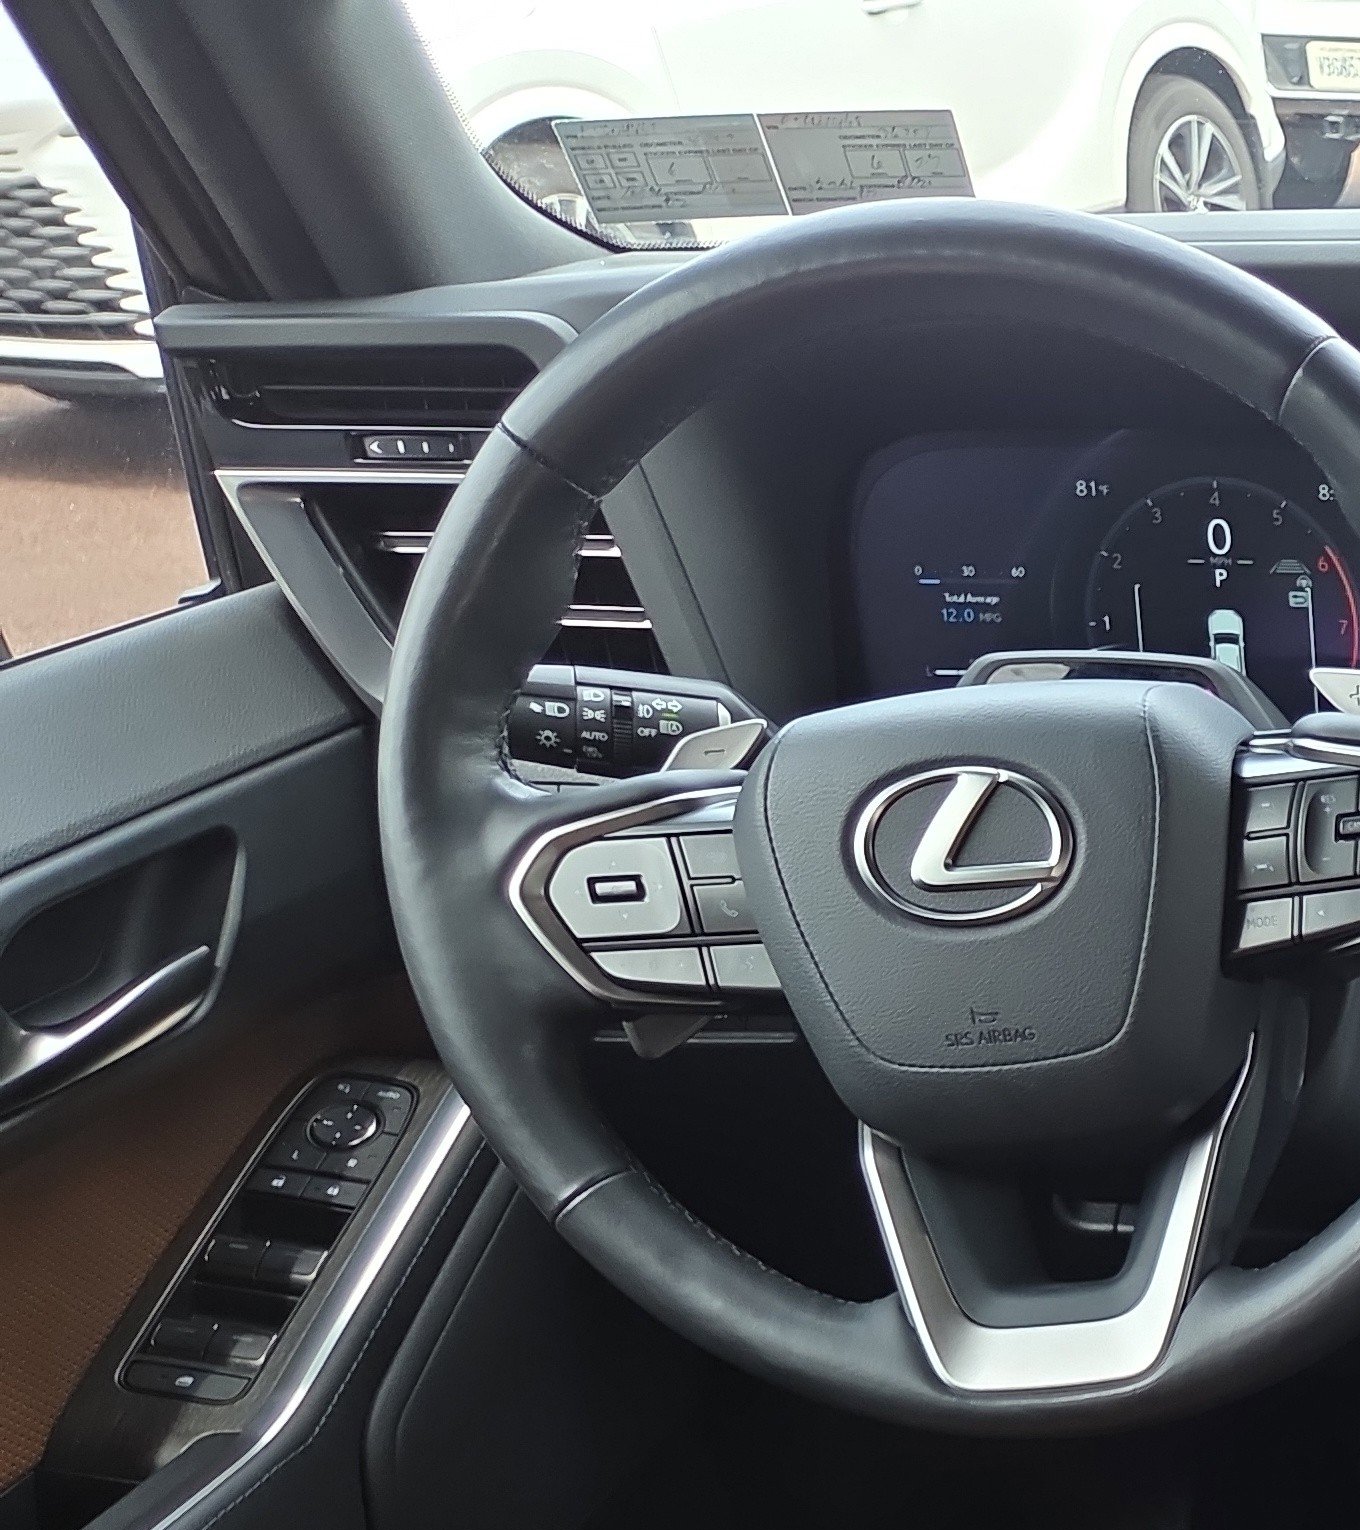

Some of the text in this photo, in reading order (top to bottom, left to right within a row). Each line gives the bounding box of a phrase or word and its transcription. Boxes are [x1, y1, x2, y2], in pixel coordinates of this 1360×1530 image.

[1209, 491, 1220, 507] 4
[1152, 507, 1163, 524] 3
[1271, 509, 1283, 526] 5
[1207, 518, 1232, 555] 0
[1112, 553, 1123, 569] 2
[1317, 556, 1328, 573] 6
[914, 565, 923, 576] 0
[961, 565, 976, 577] 30
[1214, 568, 1228, 588] P
[941, 607, 975, 622] 12.0
[1102, 615, 1111, 631] 1
[1338, 619, 1348, 636] 7
[580, 730, 609, 742] AUTO
[637, 726, 658, 738] OFF
[1246, 915, 1278, 929] MODE
[978, 1026, 1036, 1045] AIRBAG
